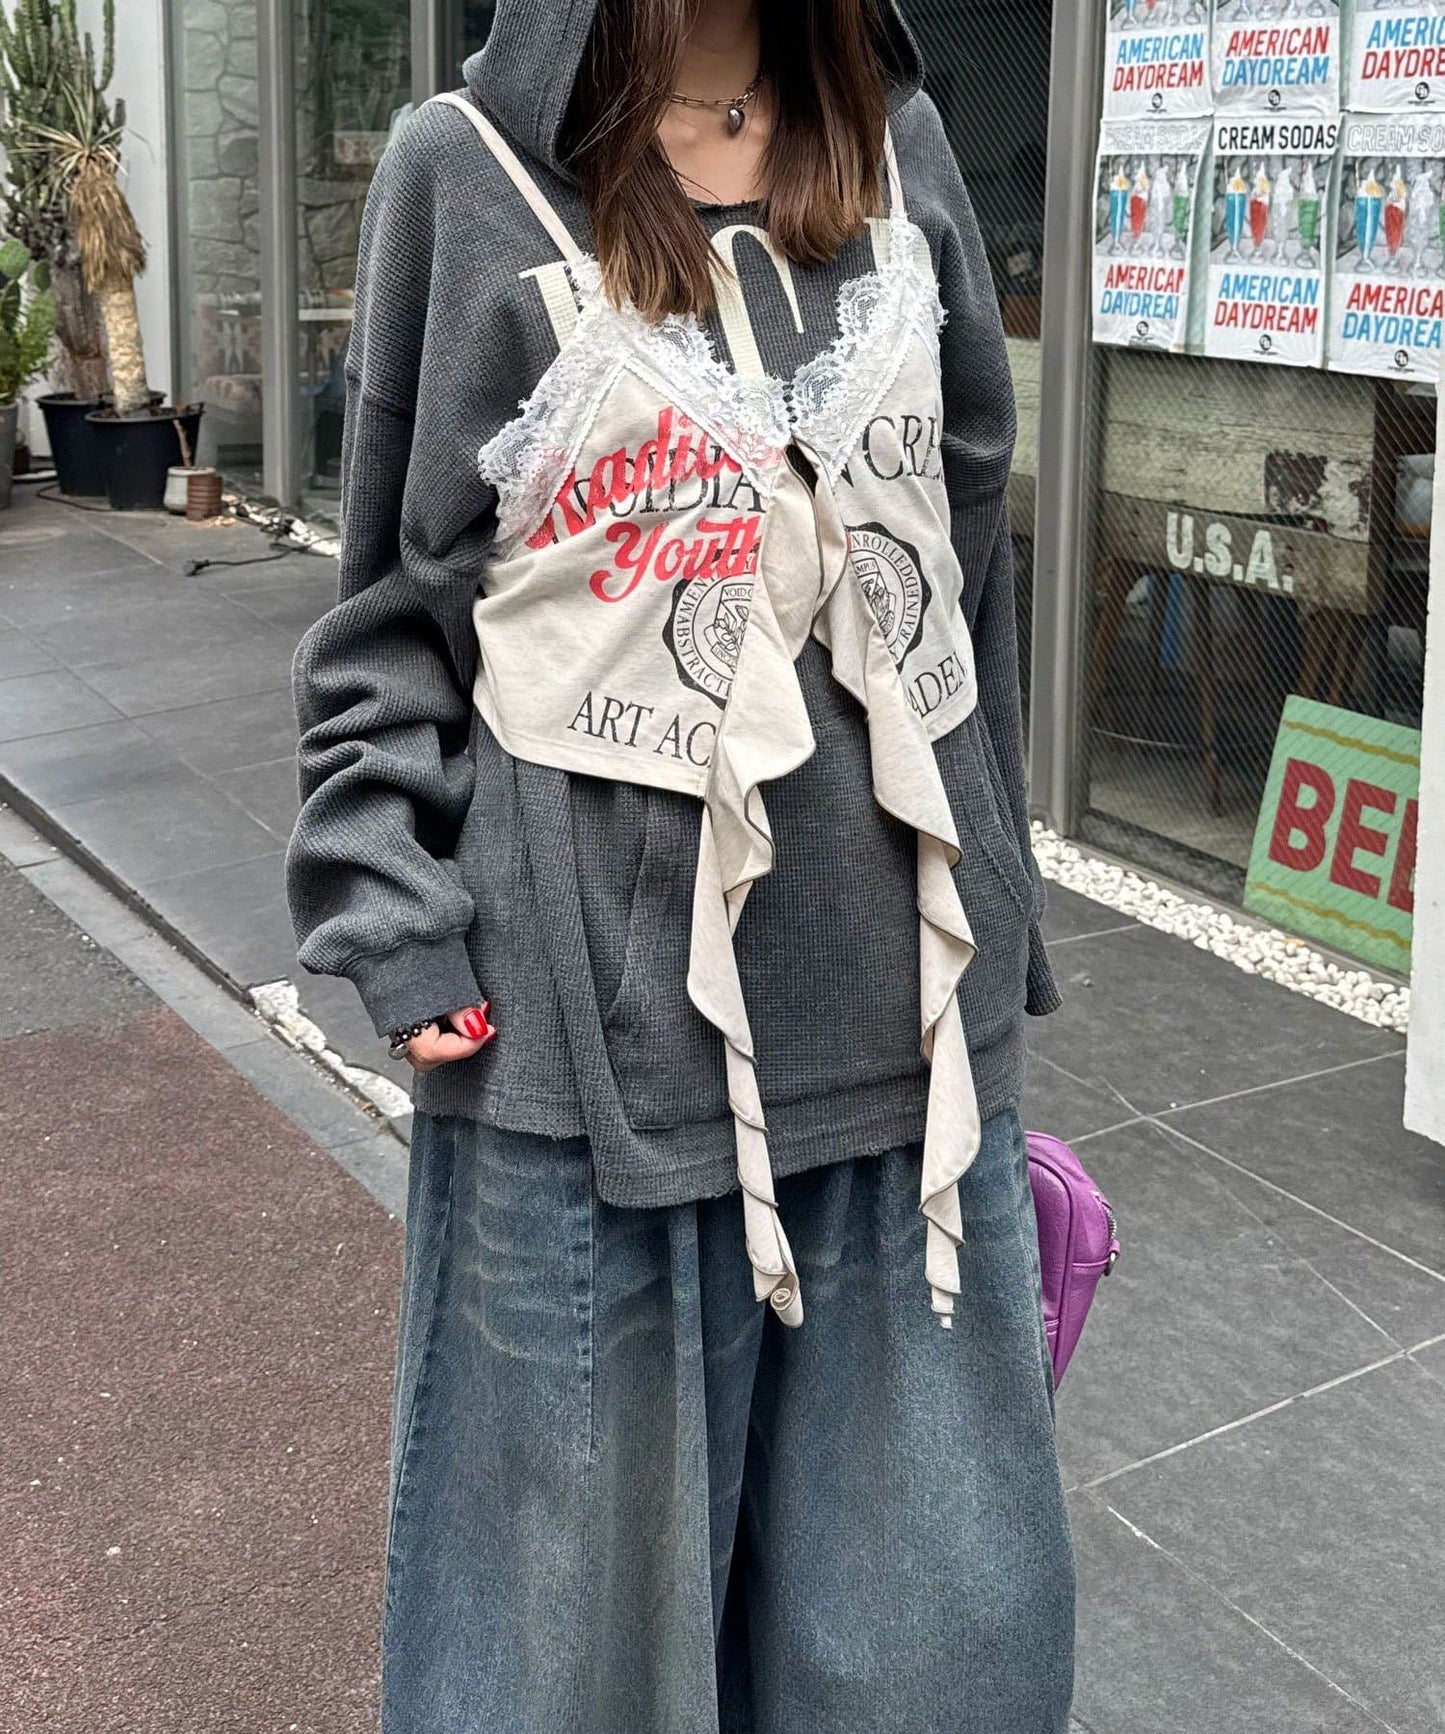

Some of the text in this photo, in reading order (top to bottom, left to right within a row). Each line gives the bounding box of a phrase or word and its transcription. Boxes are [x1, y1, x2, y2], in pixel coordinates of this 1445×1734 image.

[1117, 33, 1204, 64] AMERICAN
[1225, 26, 1330, 57] AMERICAN
[1113, 61, 1204, 91] DAYDREAM
[1222, 56, 1330, 86] DAYDREAM
[1218, 125, 1274, 149] CREAM
[1279, 124, 1337, 149] SODAS
[1347, 124, 1415, 152] CREAM
[1100, 290, 1179, 319] DAYDREA
[1218, 273, 1319, 305] AMERICAN
[1214, 301, 1318, 334] DAYDREAM
[1166, 511, 1293, 593] U.S.A.
[566, 691, 654, 748] ART
